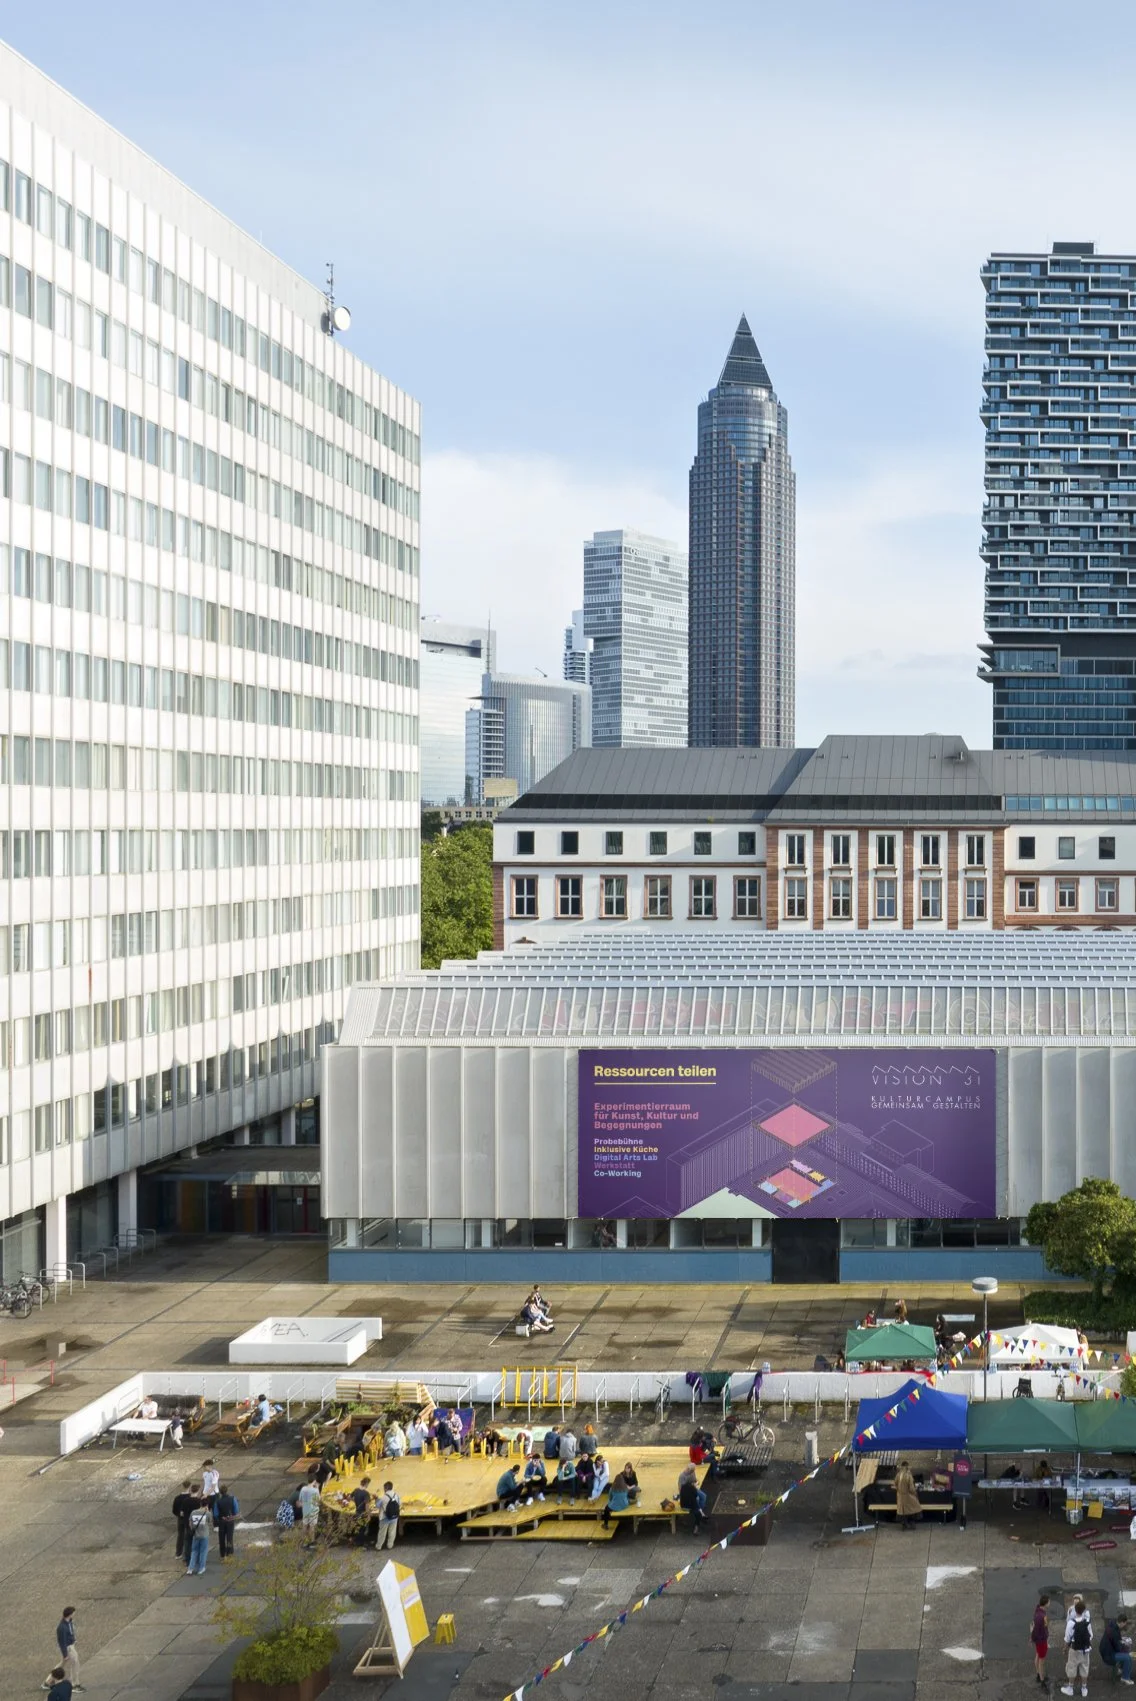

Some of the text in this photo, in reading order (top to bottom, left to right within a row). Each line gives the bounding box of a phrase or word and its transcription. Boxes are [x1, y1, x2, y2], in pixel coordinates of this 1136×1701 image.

[594, 1065, 717, 1077] Ressourcen teilen
[872, 1075, 981, 1085] VISION 31
[594, 1102, 691, 1112] Experimentierraum
[594, 1111, 699, 1121] für Kunst, Kultur und
[594, 1121, 662, 1130] Begegnungen
[594, 1154, 622, 1162] Digital
[594, 1170, 642, 1178] Co-Working
